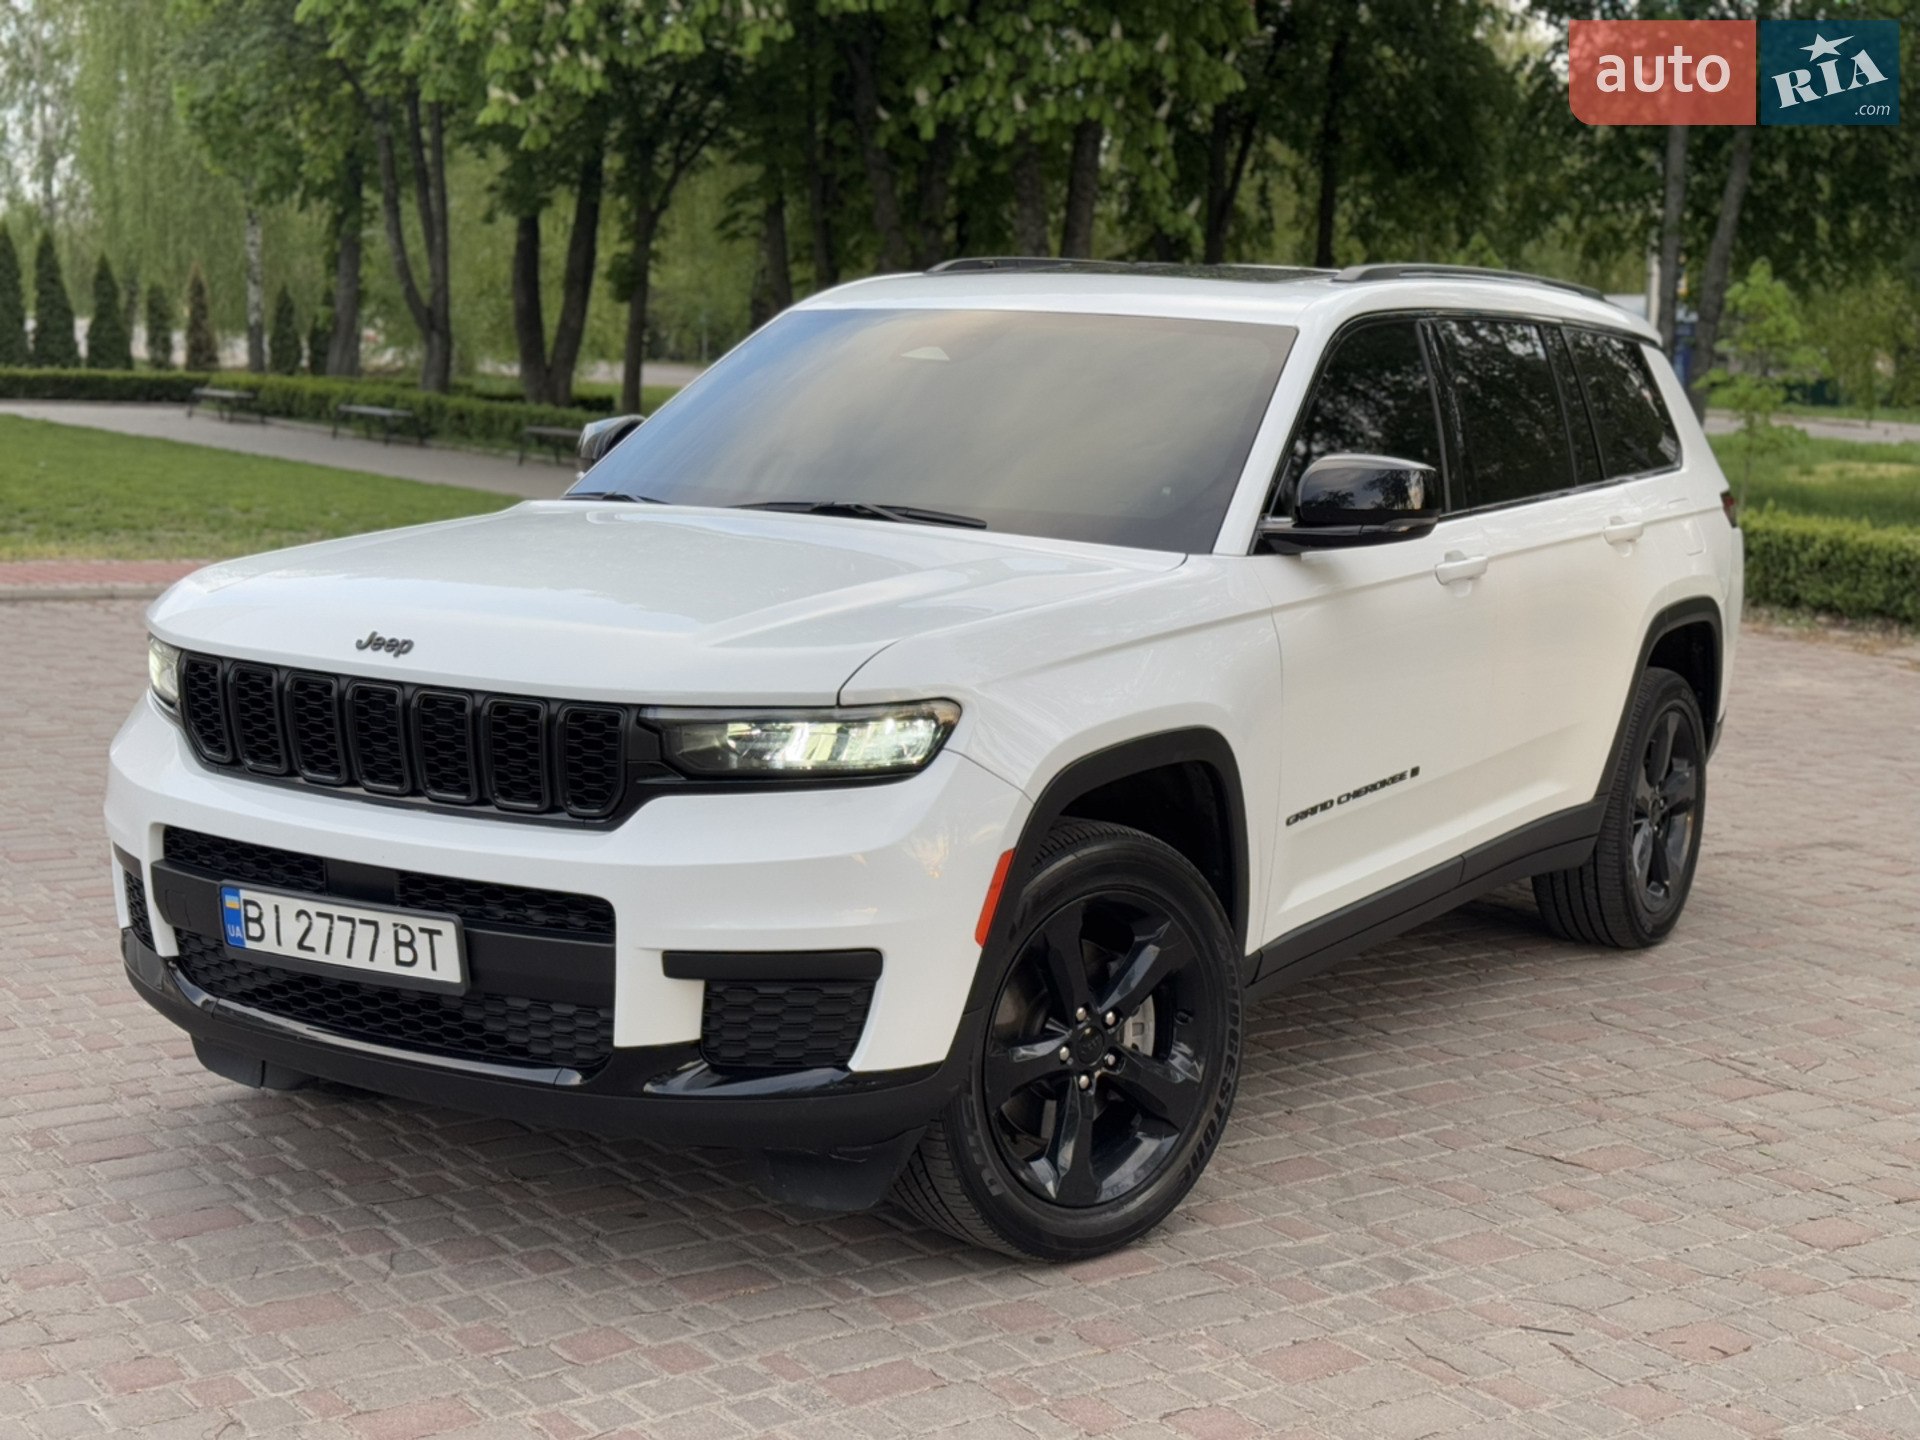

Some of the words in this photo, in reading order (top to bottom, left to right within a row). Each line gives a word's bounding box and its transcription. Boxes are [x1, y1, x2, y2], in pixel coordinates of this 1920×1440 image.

[355, 631, 414, 658] Jeep
[1285, 798, 1335, 827] GRAND
[1337, 770, 1409, 806] CHEROKEE
[227, 923, 243, 940] UA
[243, 899, 282, 947] BI
[295, 909, 380, 963] 2777
[392, 922, 443, 972] BT
